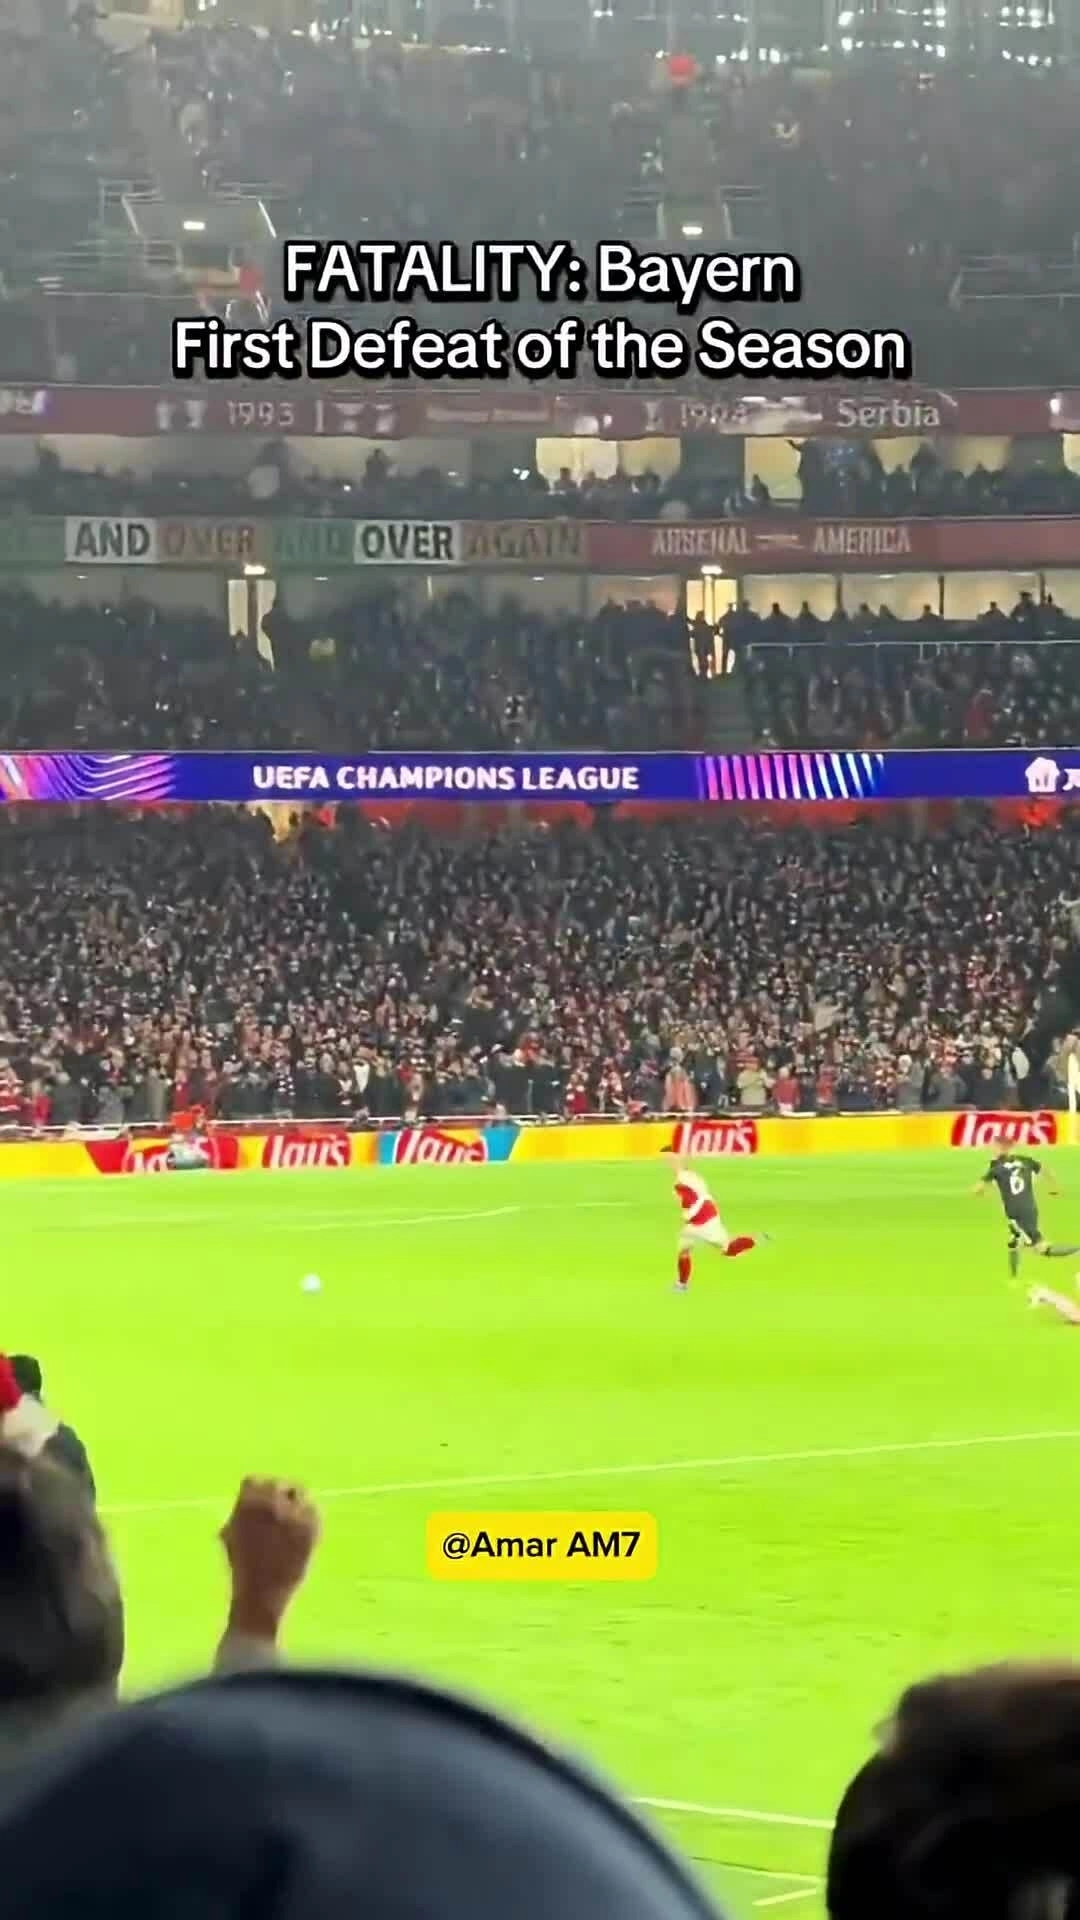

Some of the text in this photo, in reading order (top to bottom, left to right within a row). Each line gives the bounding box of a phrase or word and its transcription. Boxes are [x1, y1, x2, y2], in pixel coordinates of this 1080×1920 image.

[836, 398, 940, 428] Serbia
[74, 522, 151, 557] AND
[360, 524, 454, 560] OVER
[652, 526, 912, 554] ARSENAL AMERICA
[253, 765, 639, 791] UEFA CHAMPIONS LEAGUE
[1009, 1168, 1025, 1195] 6
